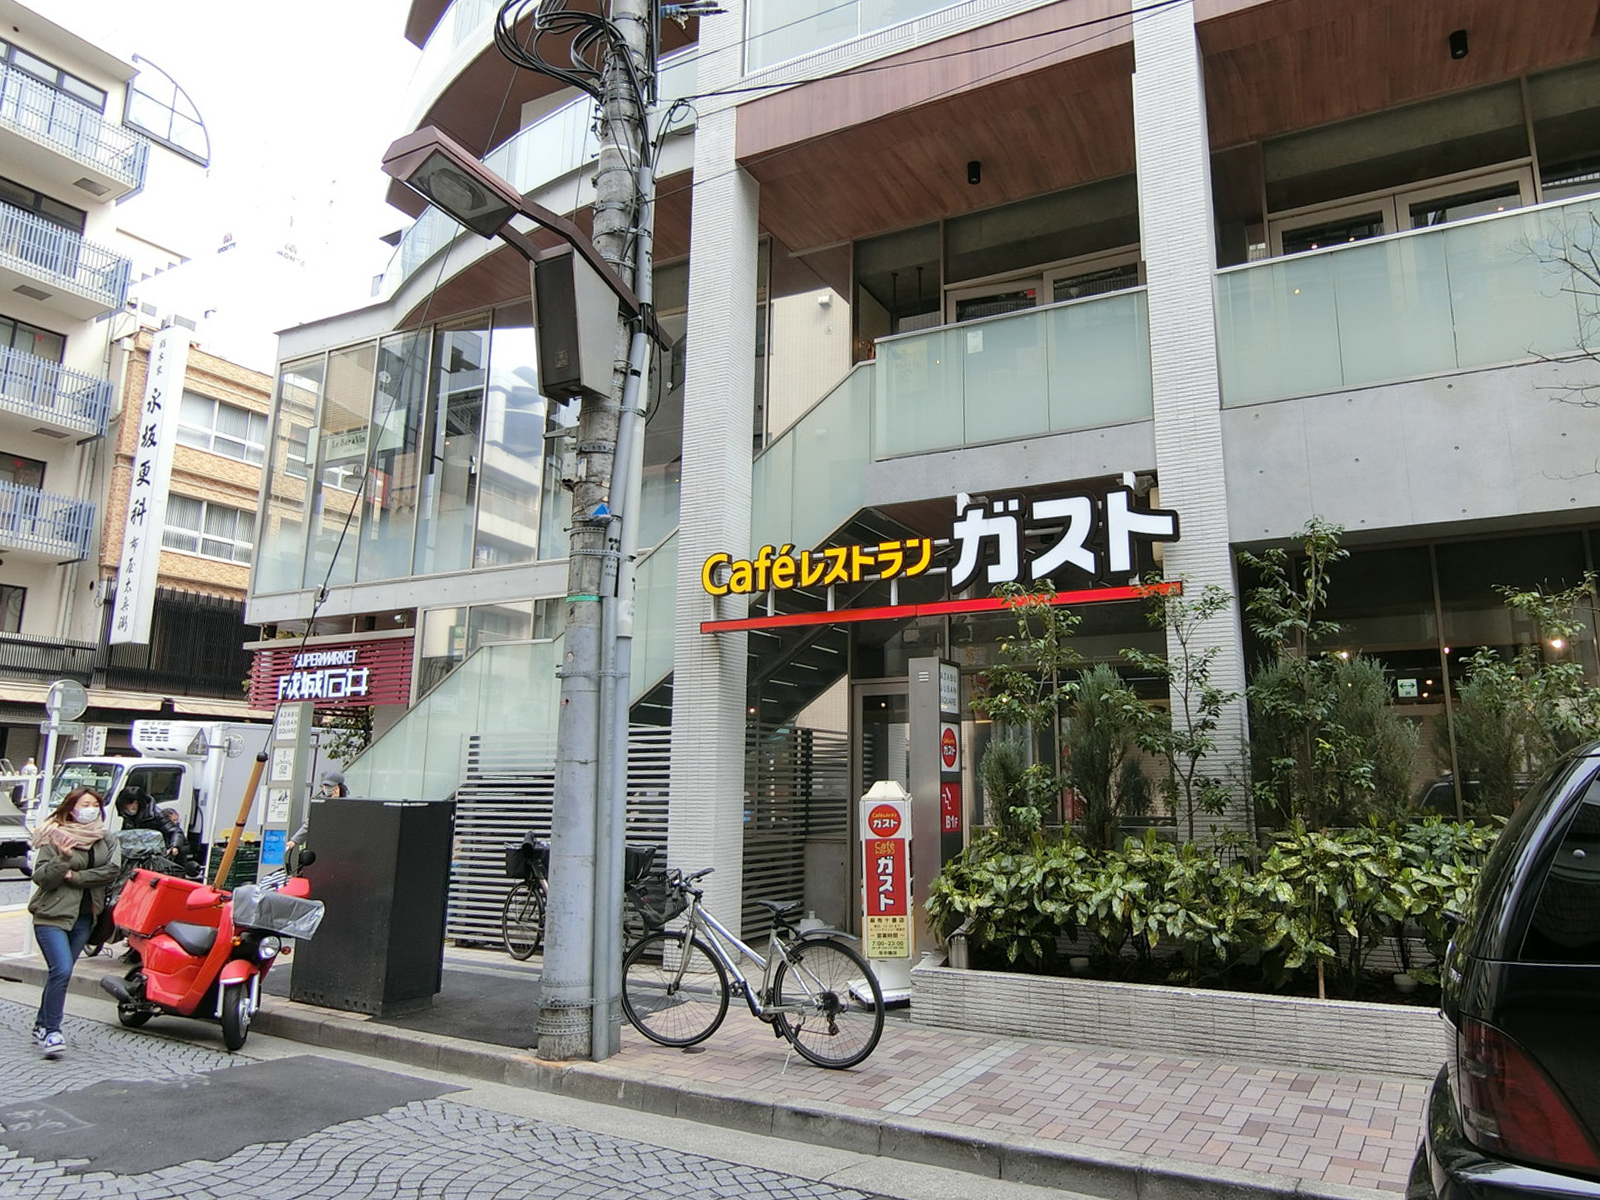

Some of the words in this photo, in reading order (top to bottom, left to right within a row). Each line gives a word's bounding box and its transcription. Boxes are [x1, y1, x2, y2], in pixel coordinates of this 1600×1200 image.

[951, 491, 1173, 588] ガスト
[278, 667, 370, 700] 成城石井
[873, 818, 898, 828] ガスト
[945, 815, 958, 829] B1F
[875, 841, 895, 849] Café
[877, 856, 894, 911] ガスト
